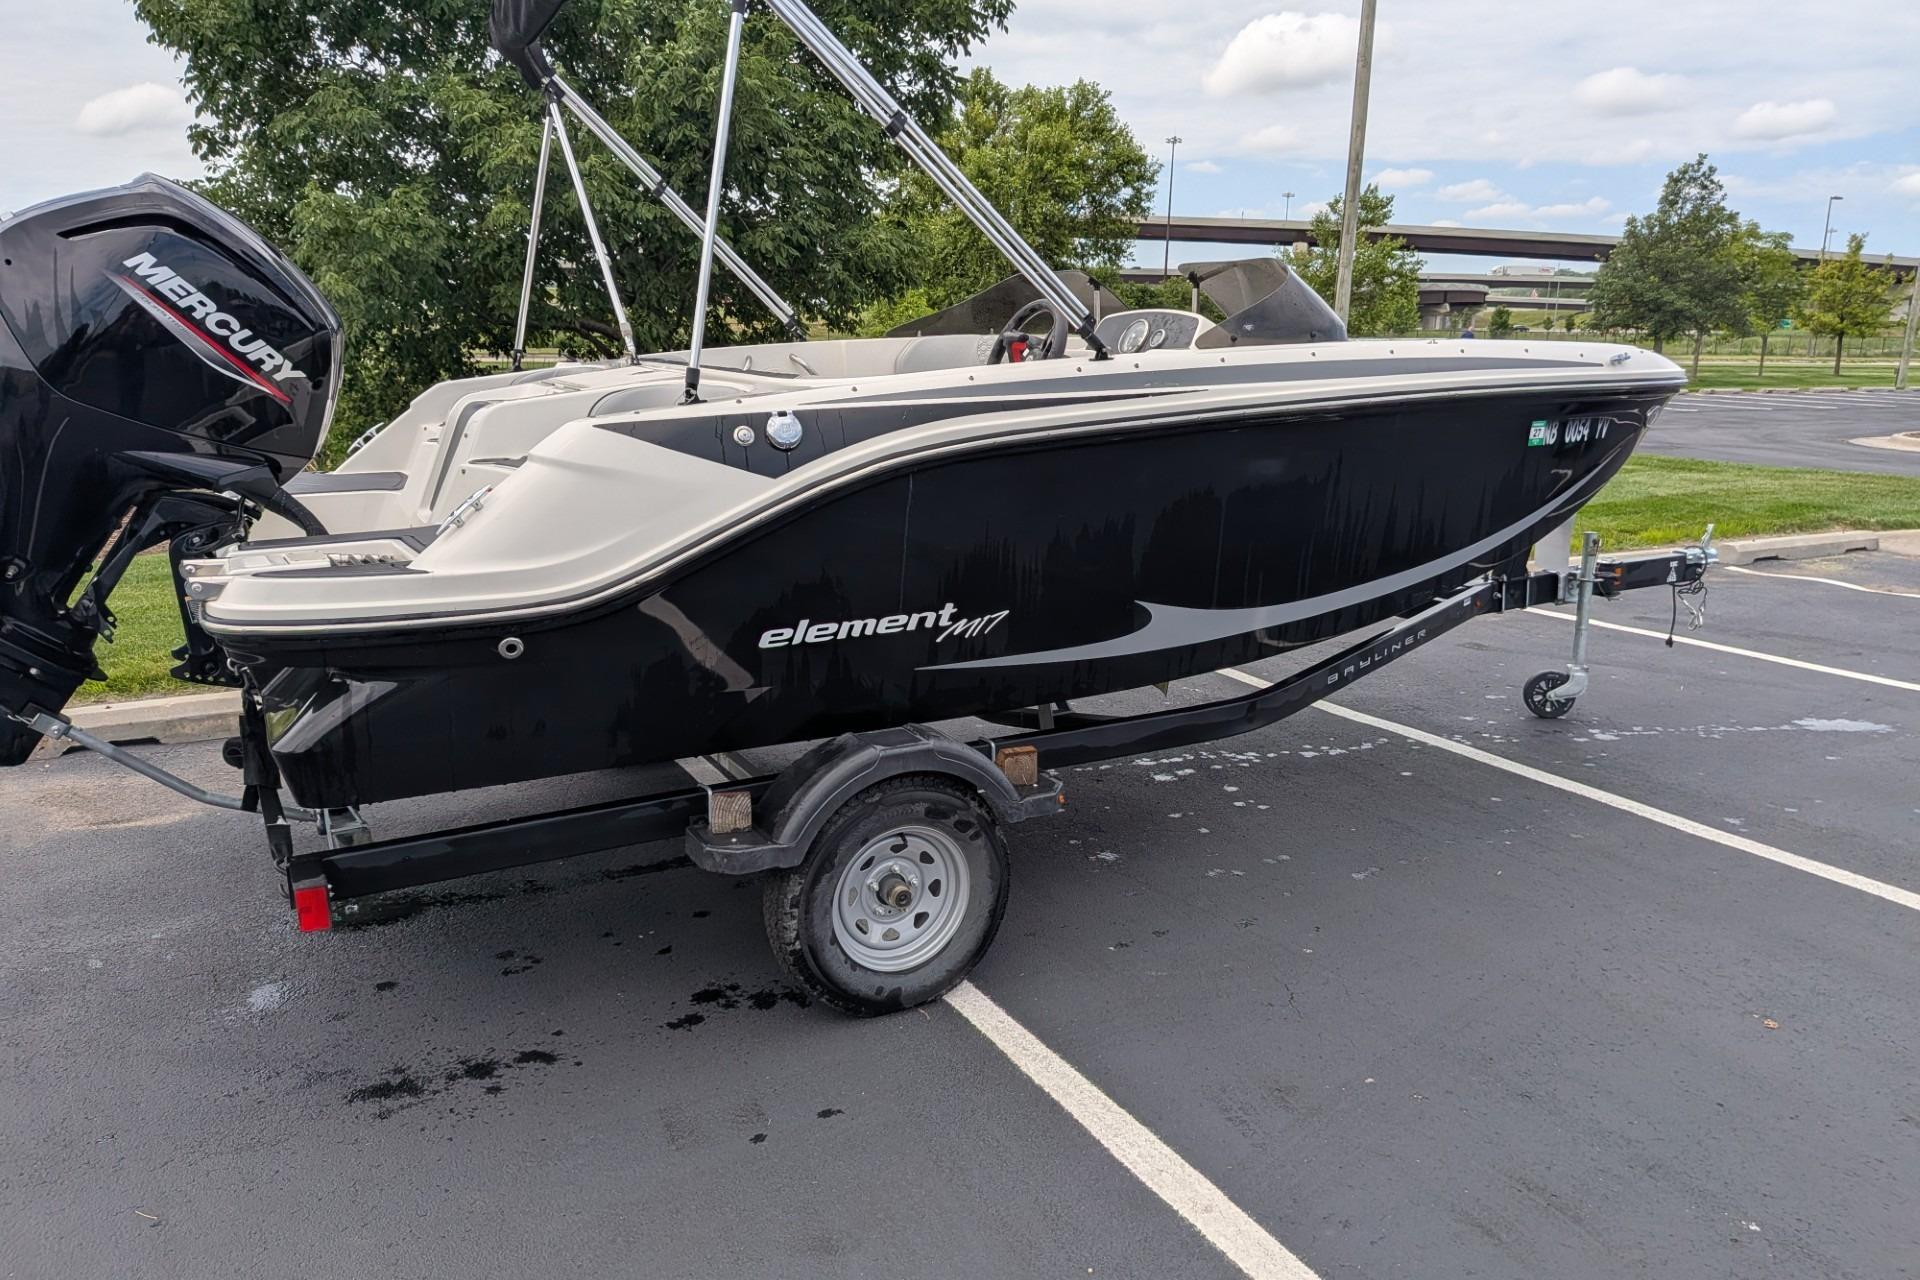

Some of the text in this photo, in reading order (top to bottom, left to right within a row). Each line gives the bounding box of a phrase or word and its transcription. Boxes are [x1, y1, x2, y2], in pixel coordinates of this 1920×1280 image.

[122, 251, 307, 381] MERCURY
[758, 603, 957, 648] element
[1327, 628, 1427, 685] BAYLINER
